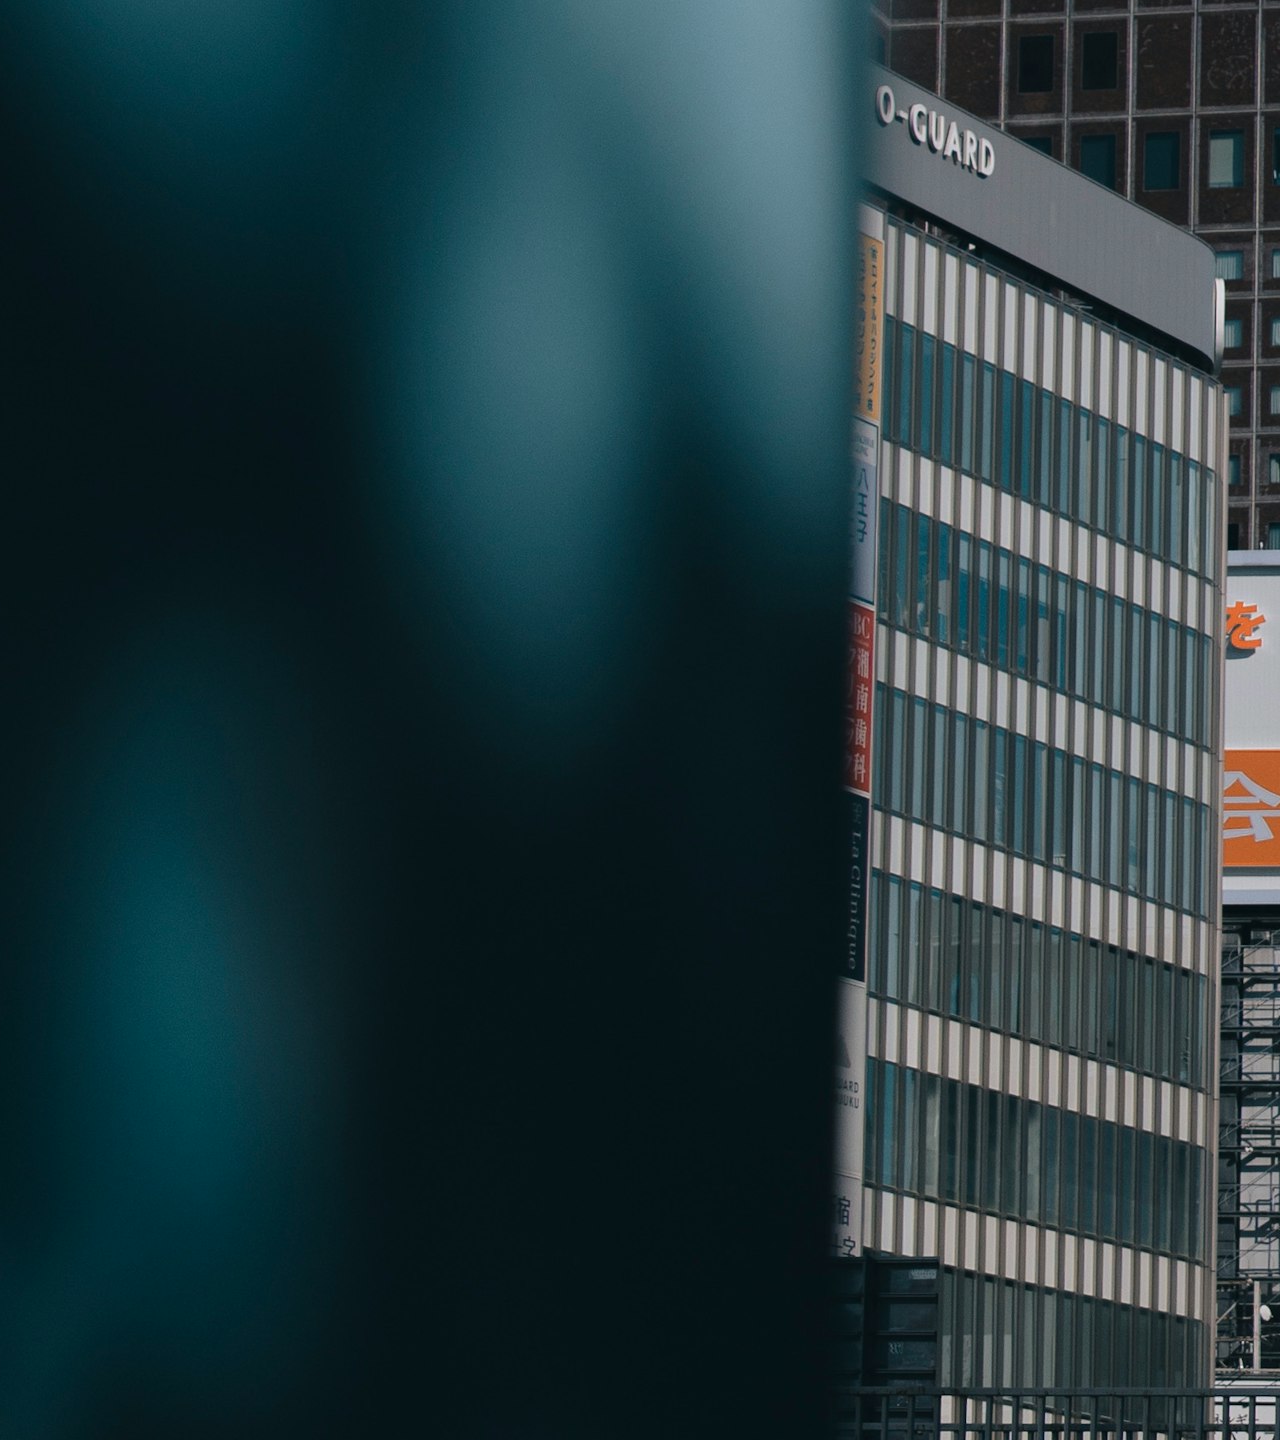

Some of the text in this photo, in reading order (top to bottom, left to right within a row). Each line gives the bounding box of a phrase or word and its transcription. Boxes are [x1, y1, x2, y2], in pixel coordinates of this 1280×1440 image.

[876, 85, 995, 176] O-GUARD
[1225, 601, 1266, 649] を
[853, 647, 870, 783] 湘南歯科
[846, 864, 861, 971] Clinique
